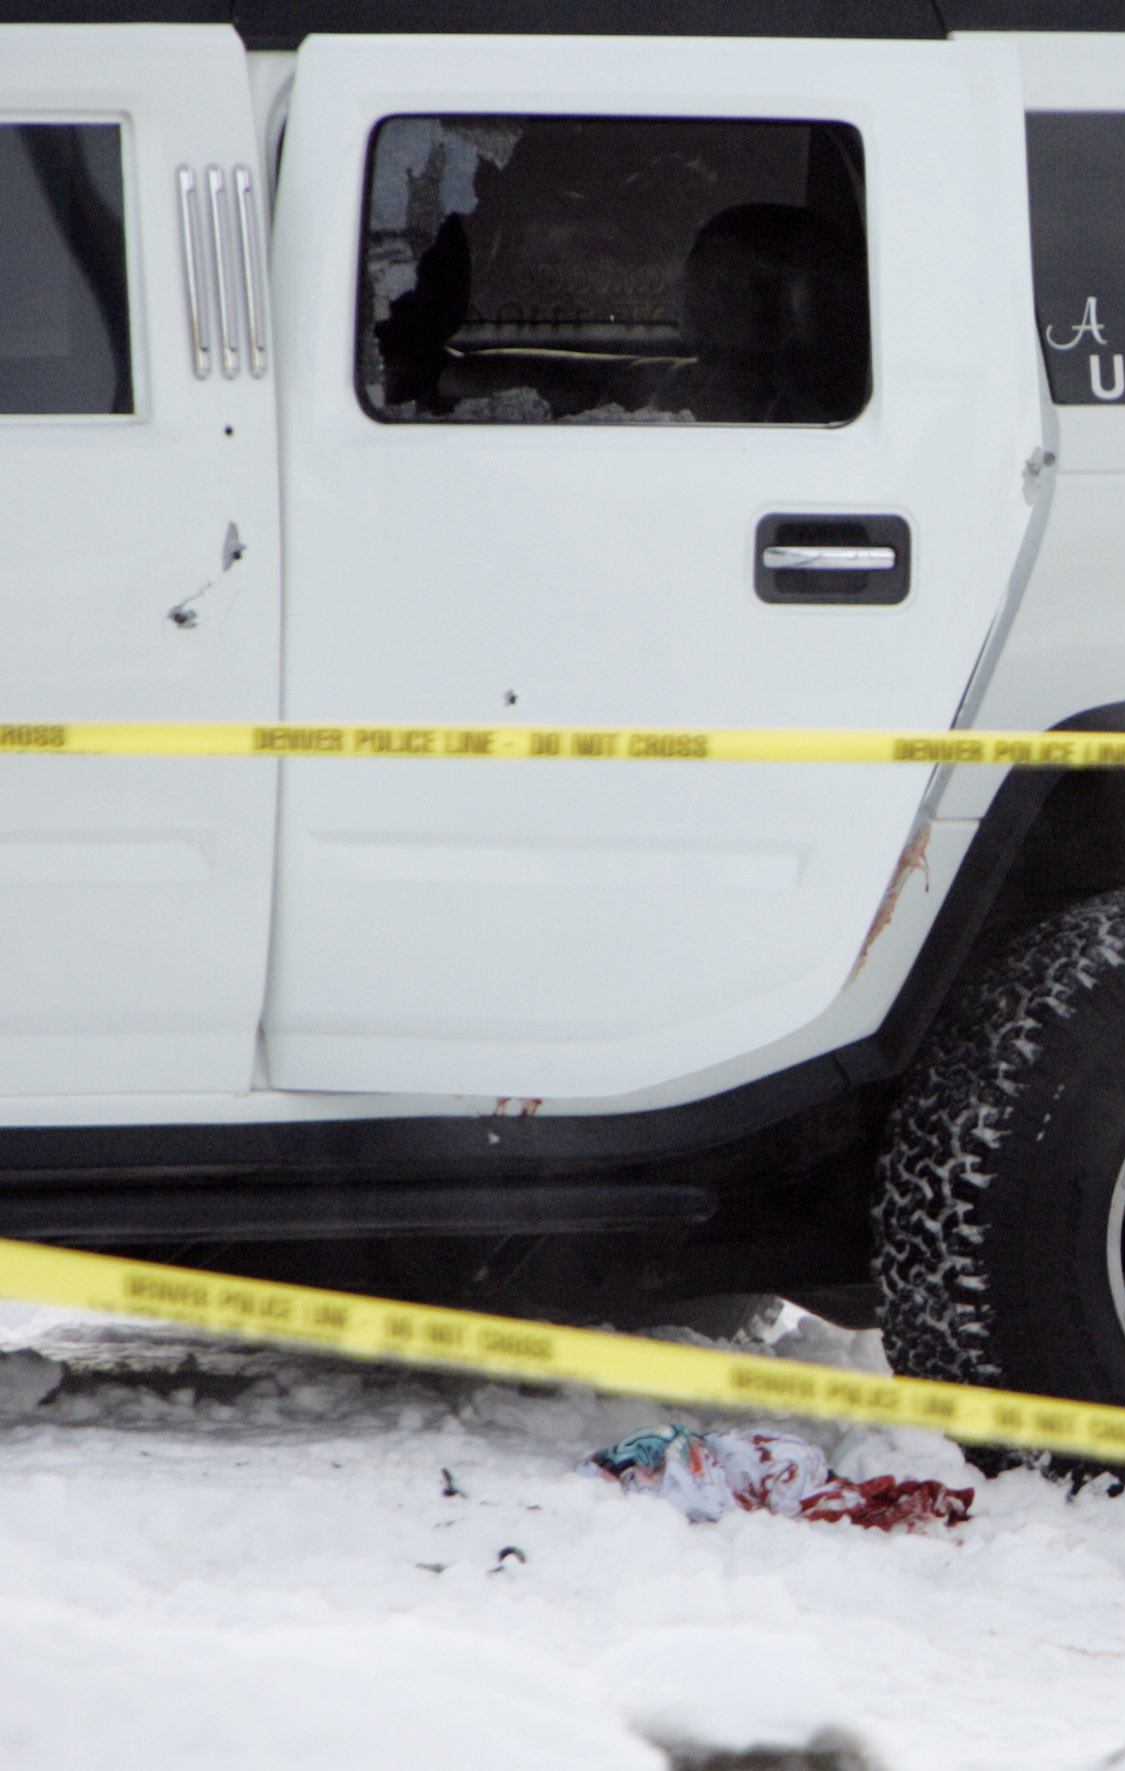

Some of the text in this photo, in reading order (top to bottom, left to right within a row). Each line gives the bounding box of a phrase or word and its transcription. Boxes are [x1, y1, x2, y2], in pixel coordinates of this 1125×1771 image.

[1046, 295, 1107, 350] A
[253, 727, 343, 750] DENVER
[354, 729, 435, 753] POLICE
[445, 731, 494, 754] LINE
[530, 732, 559, 757] DO
[570, 733, 618, 757] NOT
[628, 733, 708, 758] CROSS
[893, 738, 983, 762] DENVER
[994, 740, 1074, 764] POLICE
